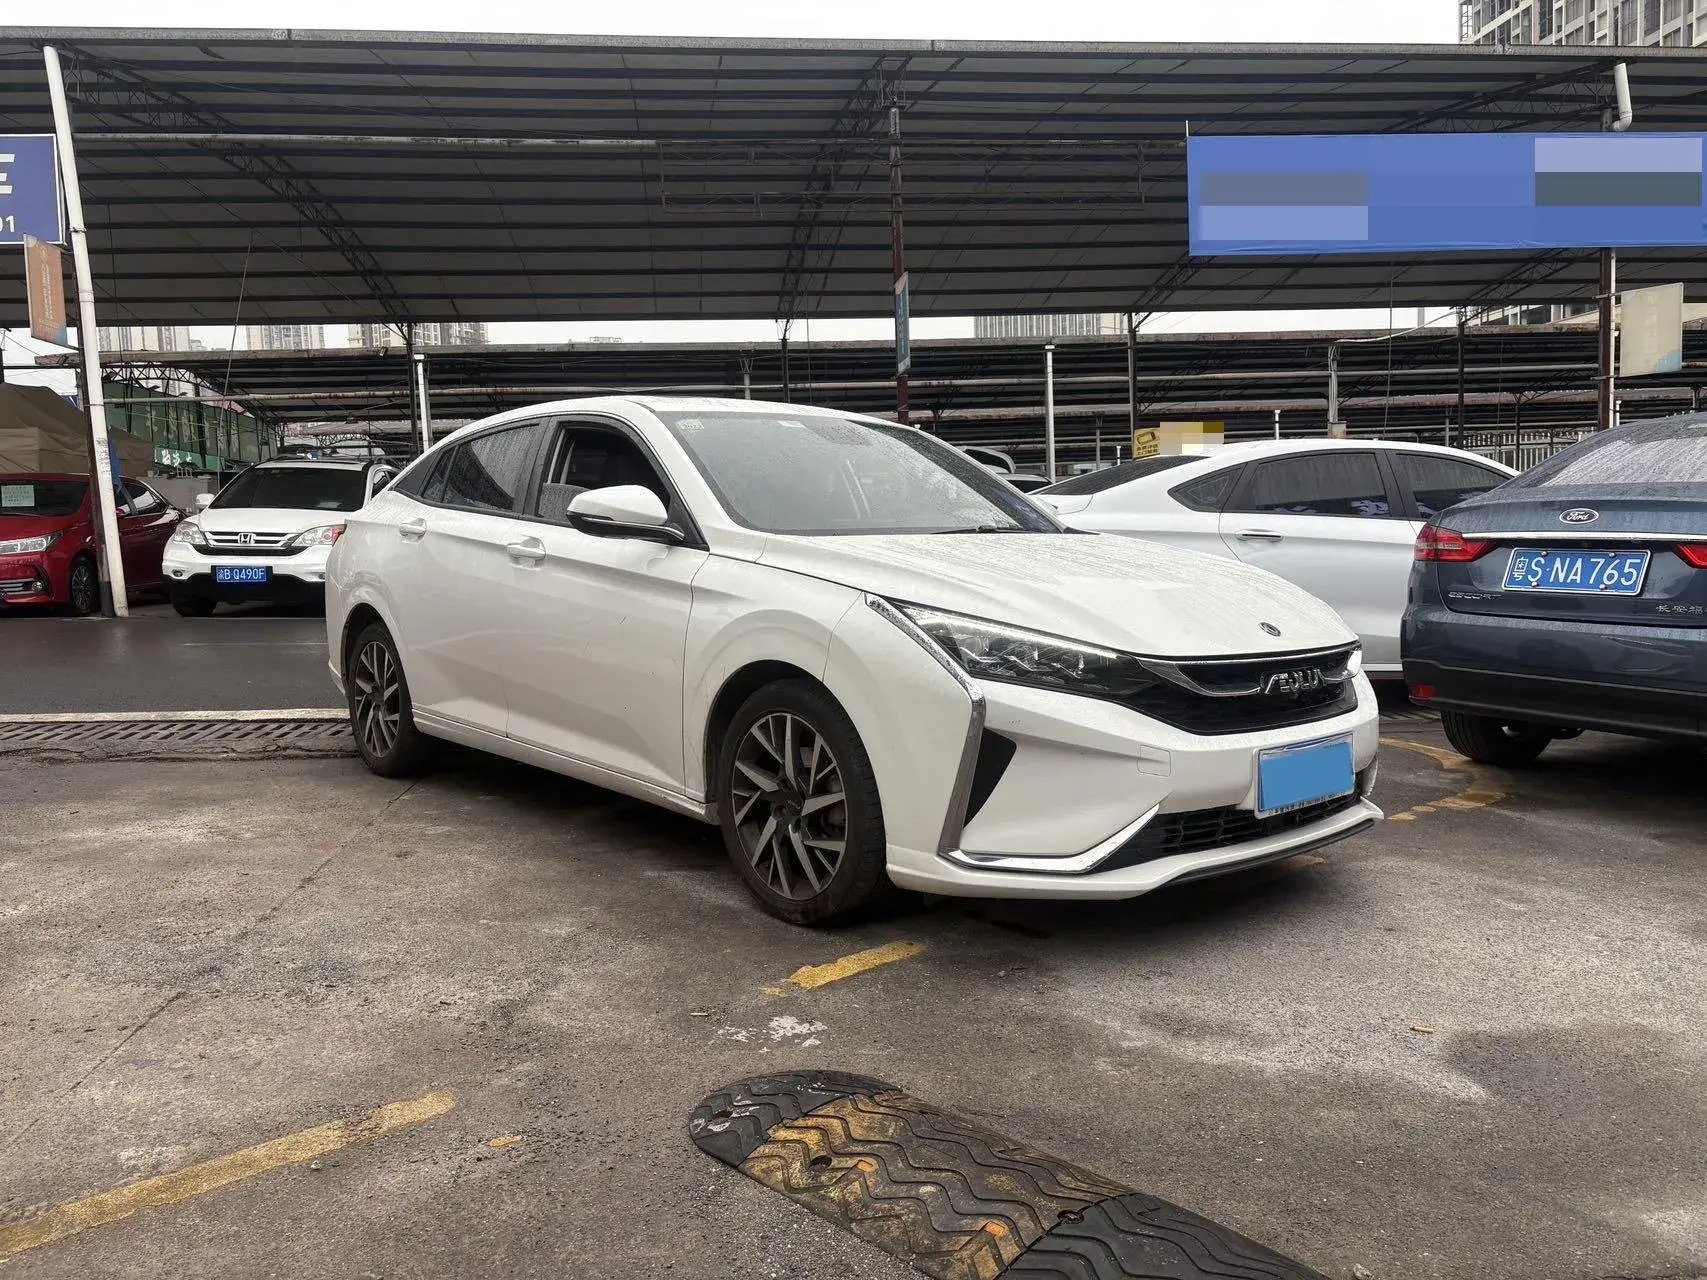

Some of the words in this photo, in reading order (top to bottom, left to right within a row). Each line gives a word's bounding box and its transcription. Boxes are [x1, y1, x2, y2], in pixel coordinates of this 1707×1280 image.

[1512, 556, 1642, 586] 粤S·NA765
[1656, 604, 1707, 615] 长安福
